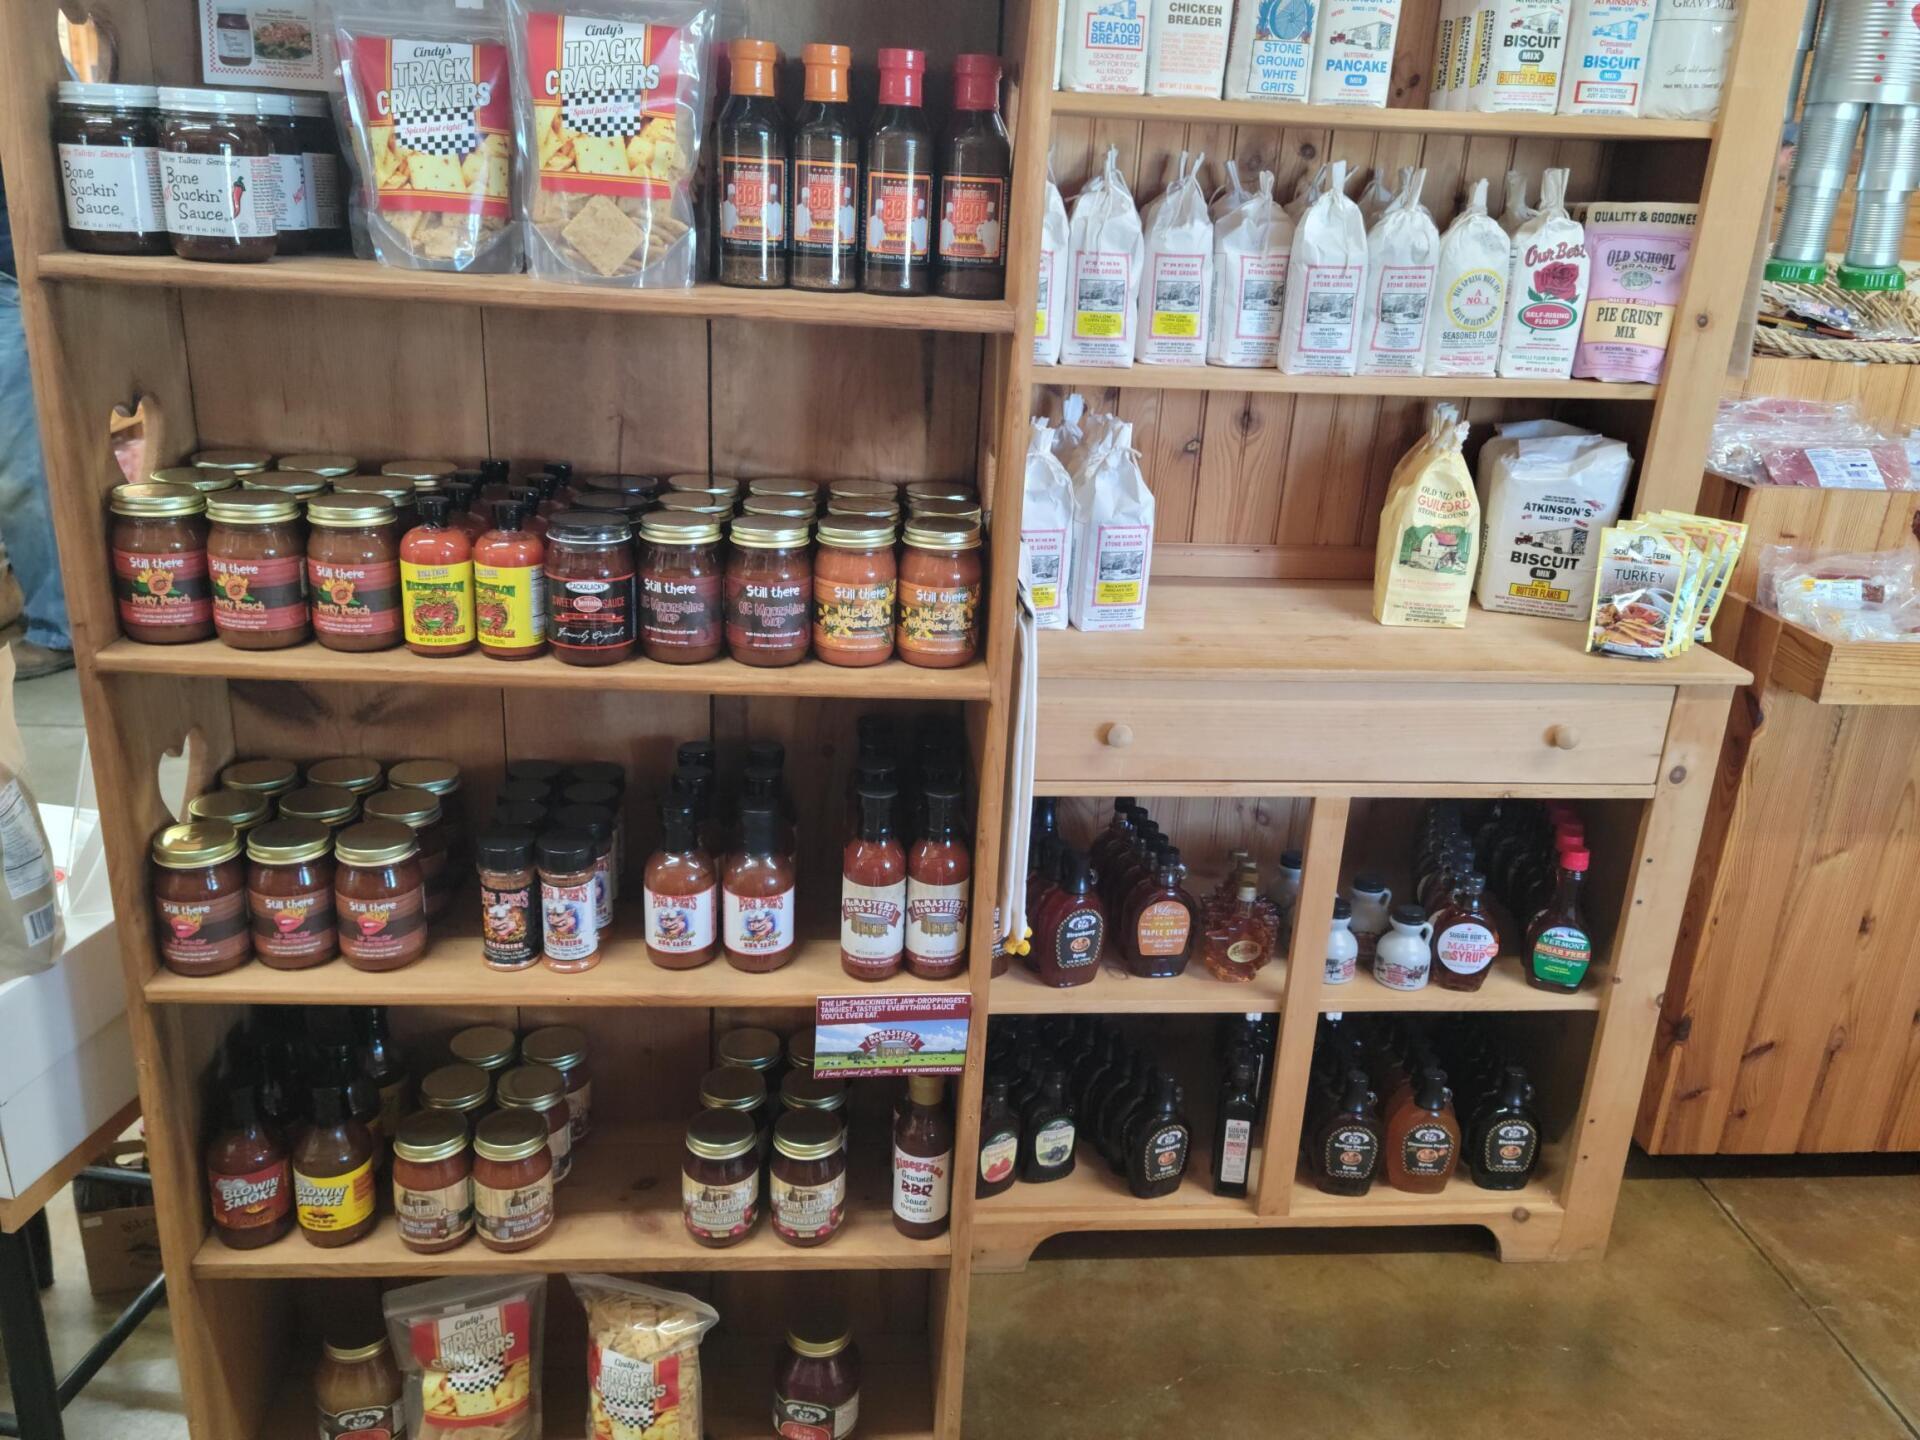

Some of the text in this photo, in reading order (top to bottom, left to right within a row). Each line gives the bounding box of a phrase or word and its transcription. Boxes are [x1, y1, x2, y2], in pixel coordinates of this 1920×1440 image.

[1169, 2, 1222, 15] CHICKEN
[1091, 21, 1140, 34] SEAFOOD
[1168, 15, 1222, 27] BREADER
[585, 23, 624, 38] Cindy's
[1091, 32, 1140, 46] BREADER
[1504, 35, 1561, 48] BISCUIT
[1599, 40, 1632, 48] Cinnamon
[413, 44, 452, 58] Cindy's
[565, 37, 641, 67] TRACK
[1264, 42, 1302, 55] STONE
[1092, 52, 1124, 60] SEASONED
[1256, 55, 1304, 68] GROUND
[1521, 52, 1541, 60] MIX
[1583, 55, 1640, 70] BISCUIT
[394, 57, 470, 87] TRACK
[1326, 59, 1388, 73] PANCAKE
[545, 64, 660, 96] CRACKERS
[1263, 69, 1297, 81] WHITE
[1499, 73, 1555, 84] BUTTER FLAKES
[1261, 82, 1295, 93] GRITS
[376, 81, 491, 116] CRACKERS
[64, 160, 94, 178] Bone
[166, 166, 199, 185] Bone
[70, 179, 118, 197] Suckin'
[171, 184, 222, 203] Suckin'
[76, 197, 120, 215] Sauce
[178, 203, 223, 220] Sauce
[1595, 211, 1648, 223] QUALITY &
[1525, 241, 1587, 267] Our Best
[1607, 250, 1676, 271] OLD SCHOOL
[1462, 274, 1481, 288] SPRING
[1525, 311, 1570, 319] SELF-RISING
[1596, 307, 1663, 327] PIE CRUST
[1443, 331, 1477, 339] SEASONED
[1615, 325, 1636, 339] MIX
[1421, 486, 1466, 498] OLD OF
[1417, 495, 1471, 513] GUILFORD
[1523, 502, 1592, 517] ATKINSON'S
[1437, 511, 1469, 520] GROUND
[129, 557, 184, 569] Still there
[212, 559, 259, 575] Still there
[1510, 551, 1580, 570] BISCUIT
[316, 565, 365, 579] Still there
[1614, 568, 1665, 583] TURKEY
[644, 578, 697, 595] Still there
[746, 585, 800, 599] Still there
[834, 586, 886, 600] Still there
[1516, 587, 1562, 599] BUTTER FLAKES
[160, 593, 191, 605] Peach
[552, 596, 625, 608] SWEET SAUCE
[916, 589, 968, 603] Still there
[341, 603, 370, 616] Peach
[265, 898, 315, 909] Still there
[349, 901, 398, 912] Still there
[653, 894, 668, 909] PIG
[739, 896, 756, 912] PIG
[163, 903, 211, 916] Still there
[486, 940, 524, 949] SEASONING
[1447, 941, 1487, 951] MAPLE
[1543, 937, 1586, 950] VERMONT
[1450, 951, 1486, 963] SYRUP
[1536, 944, 1588, 958] SUGAR FREE
[901, 1170, 934, 1182] Gourmet
[901, 1180, 933, 1197] BBQ
[224, 1186, 277, 1211] SMOKE
[904, 1194, 928, 1205] Sauce
[901, 1202, 932, 1213] Original
